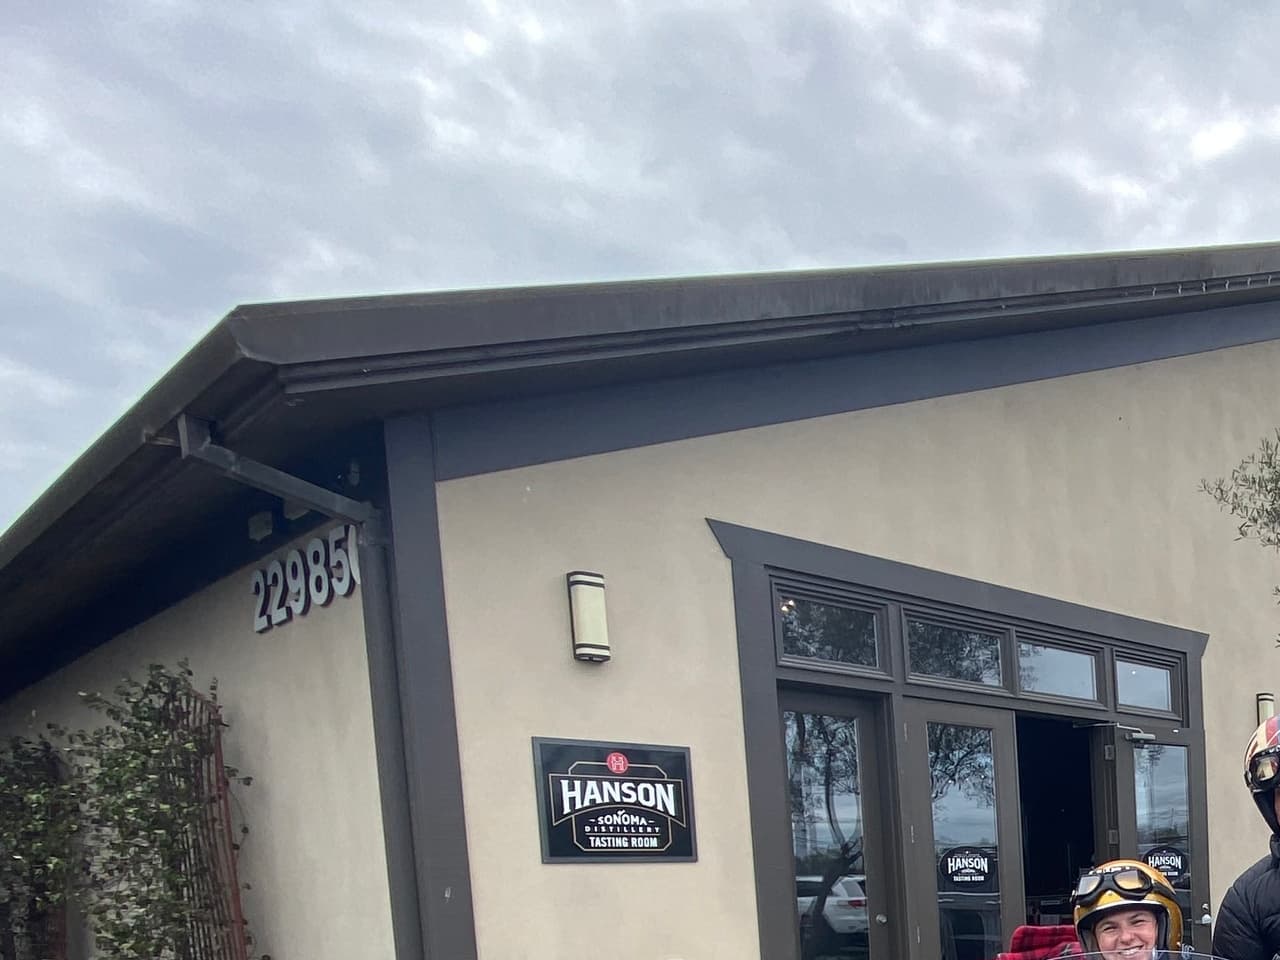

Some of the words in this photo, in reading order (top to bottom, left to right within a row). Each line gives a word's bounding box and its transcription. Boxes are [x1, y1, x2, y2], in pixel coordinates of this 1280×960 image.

[560, 780, 676, 816] HANSON
[597, 814, 647, 825] SONOMA
[589, 836, 629, 848] TASTING
[631, 837, 658, 848] ROOM
[947, 857, 988, 874] HANSON
[1148, 856, 1182, 869] HANSON
